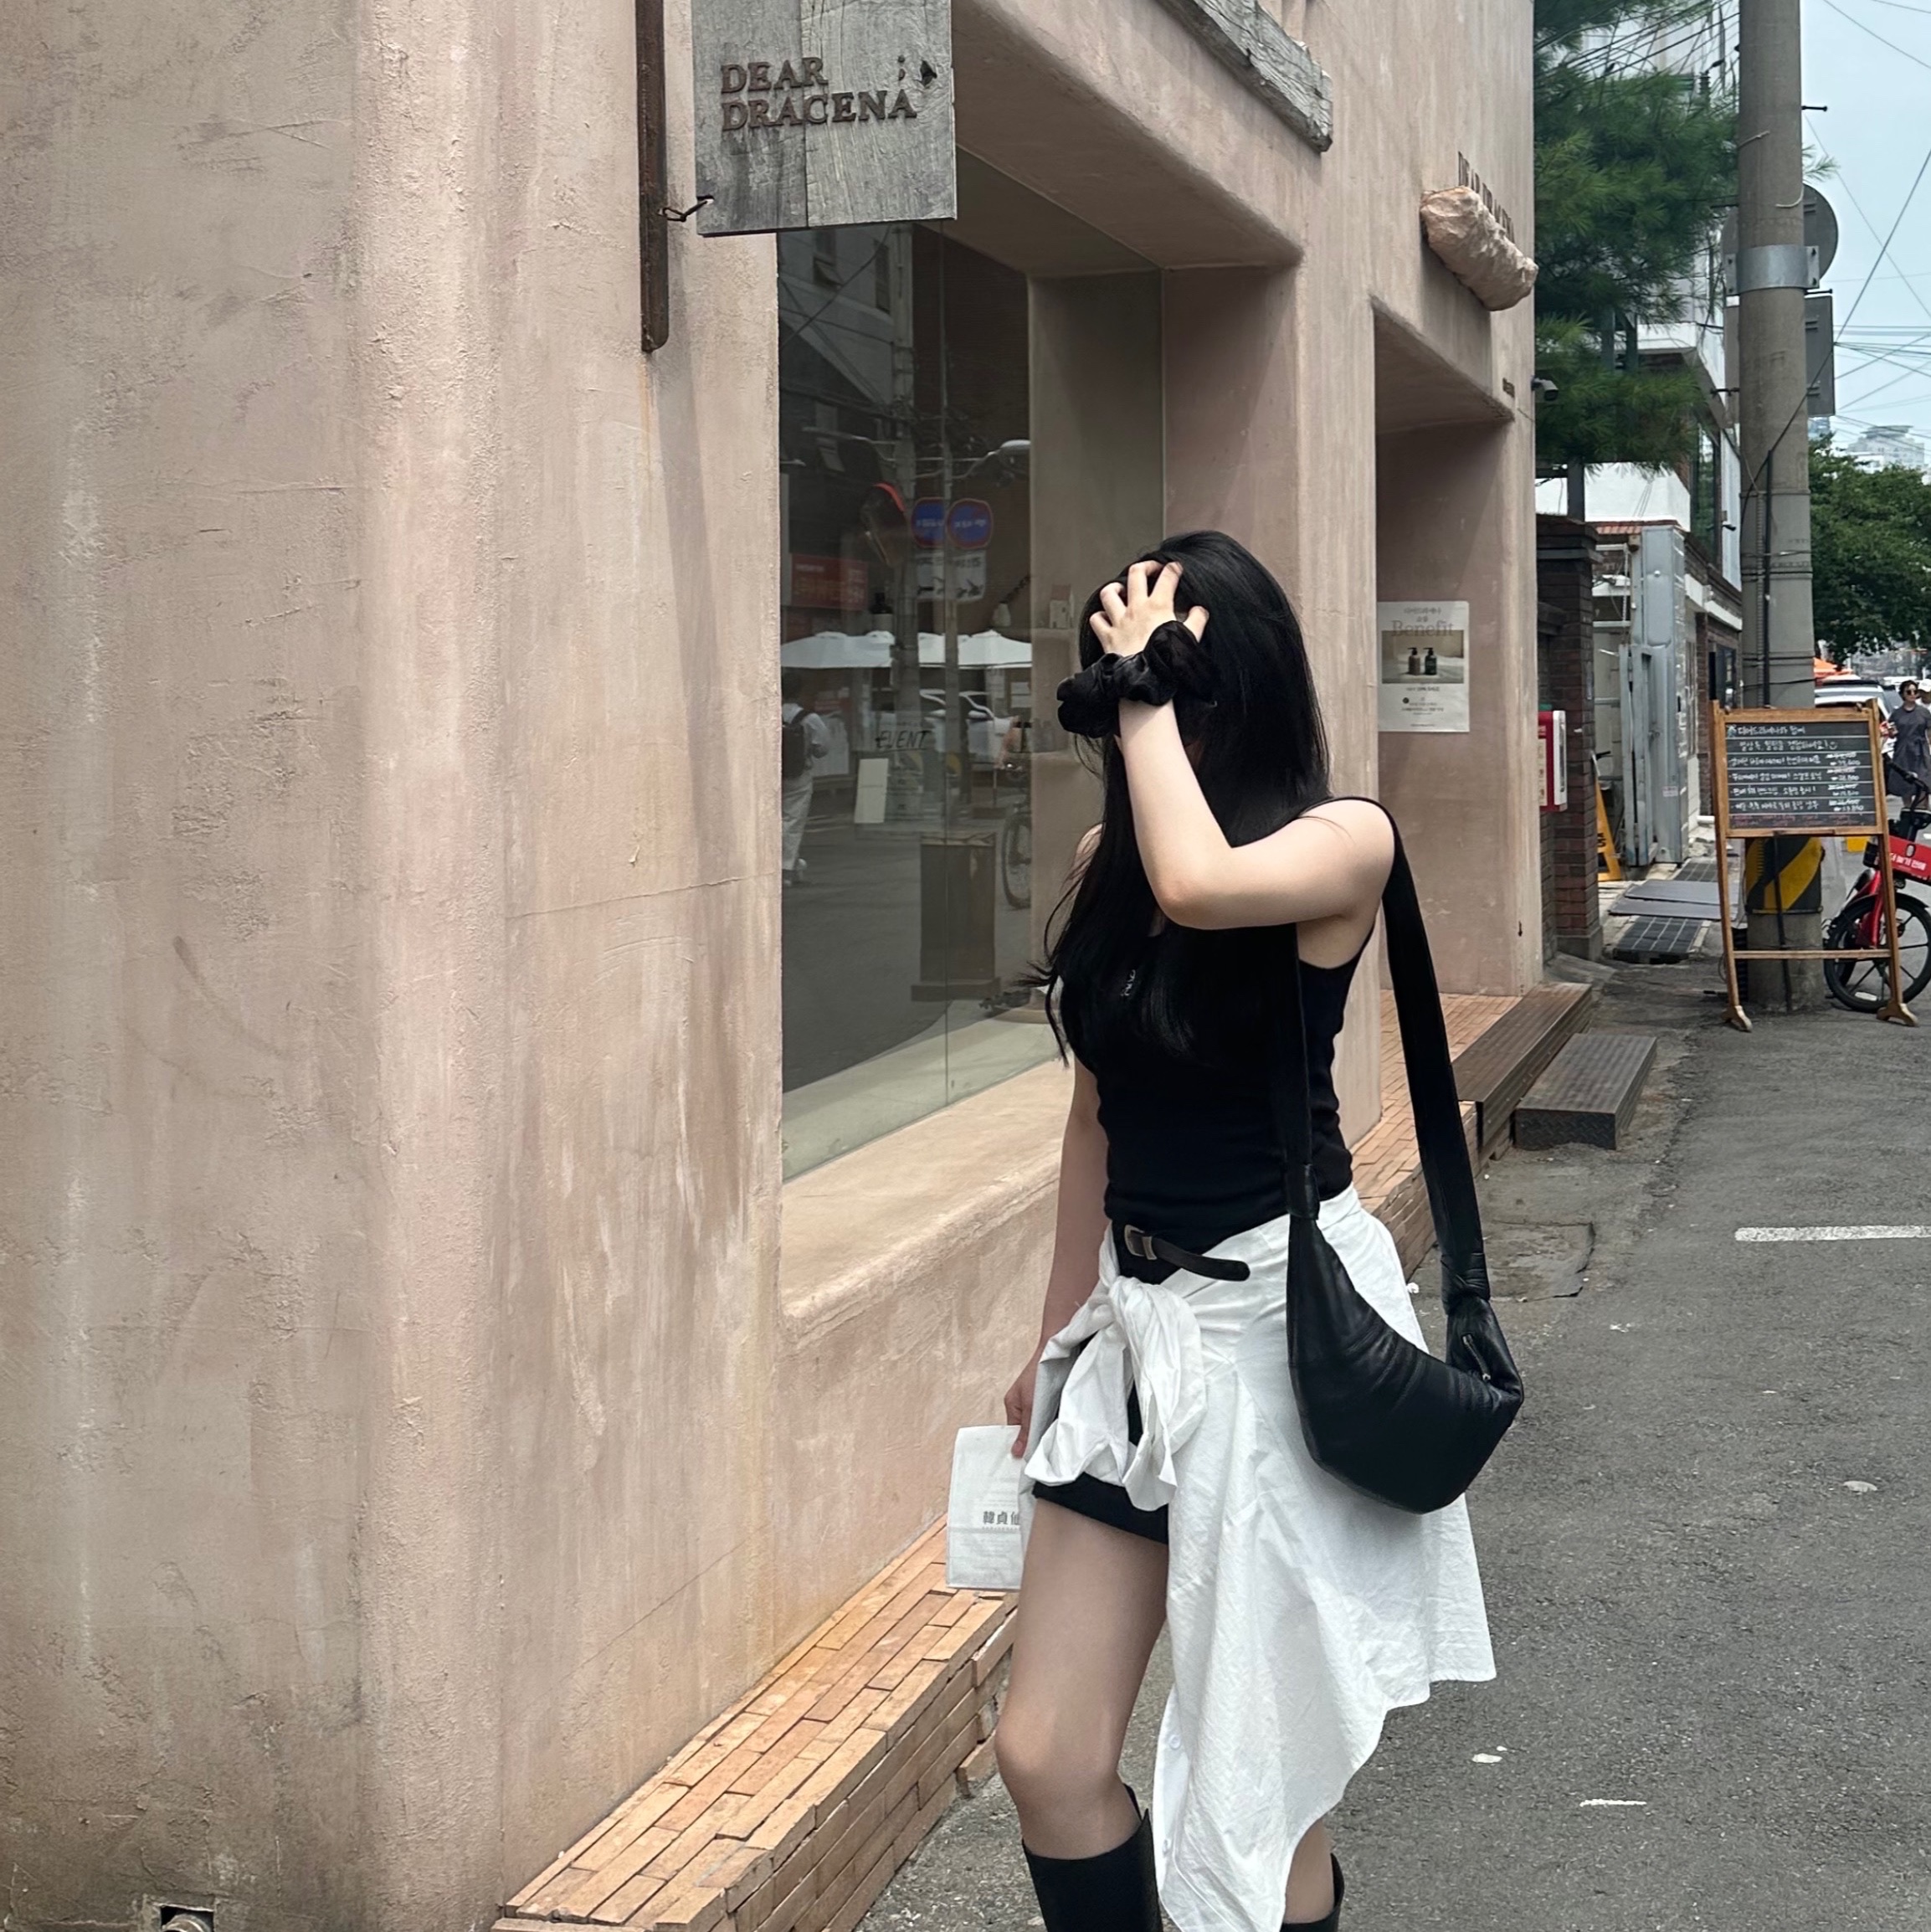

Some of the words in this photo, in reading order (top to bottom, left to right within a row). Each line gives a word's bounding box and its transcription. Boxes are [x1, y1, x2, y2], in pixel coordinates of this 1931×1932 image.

[720, 56, 829, 94] DEAR
[721, 88, 917, 132] DRACENA
[1391, 619, 1454, 637] Benefit
